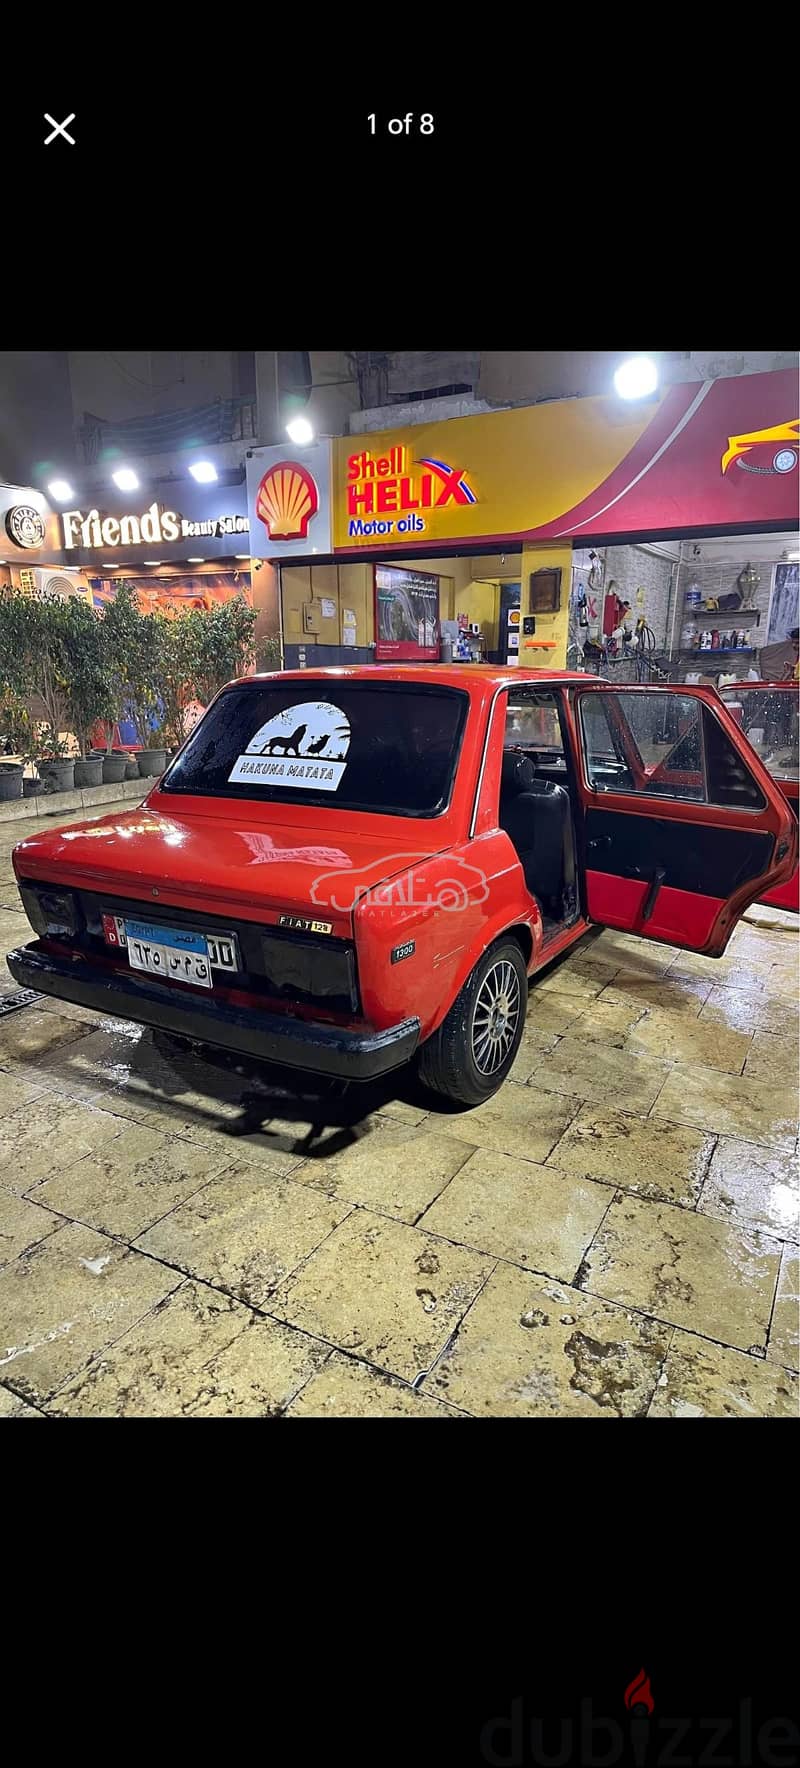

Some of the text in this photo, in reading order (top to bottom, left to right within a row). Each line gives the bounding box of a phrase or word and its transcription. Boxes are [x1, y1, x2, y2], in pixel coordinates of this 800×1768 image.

[347, 447, 404, 481] Shell
[347, 460, 475, 515] HELIX
[62, 502, 179, 549] Friends
[181, 518, 217, 537] Beauty
[219, 515, 250, 534] Salon
[349, 513, 424, 537] Motor oils
[239, 761, 335, 780] HAKUNA MATATA
[279, 916, 329, 932] FIAT 128
[396, 944, 413, 959] 1300
